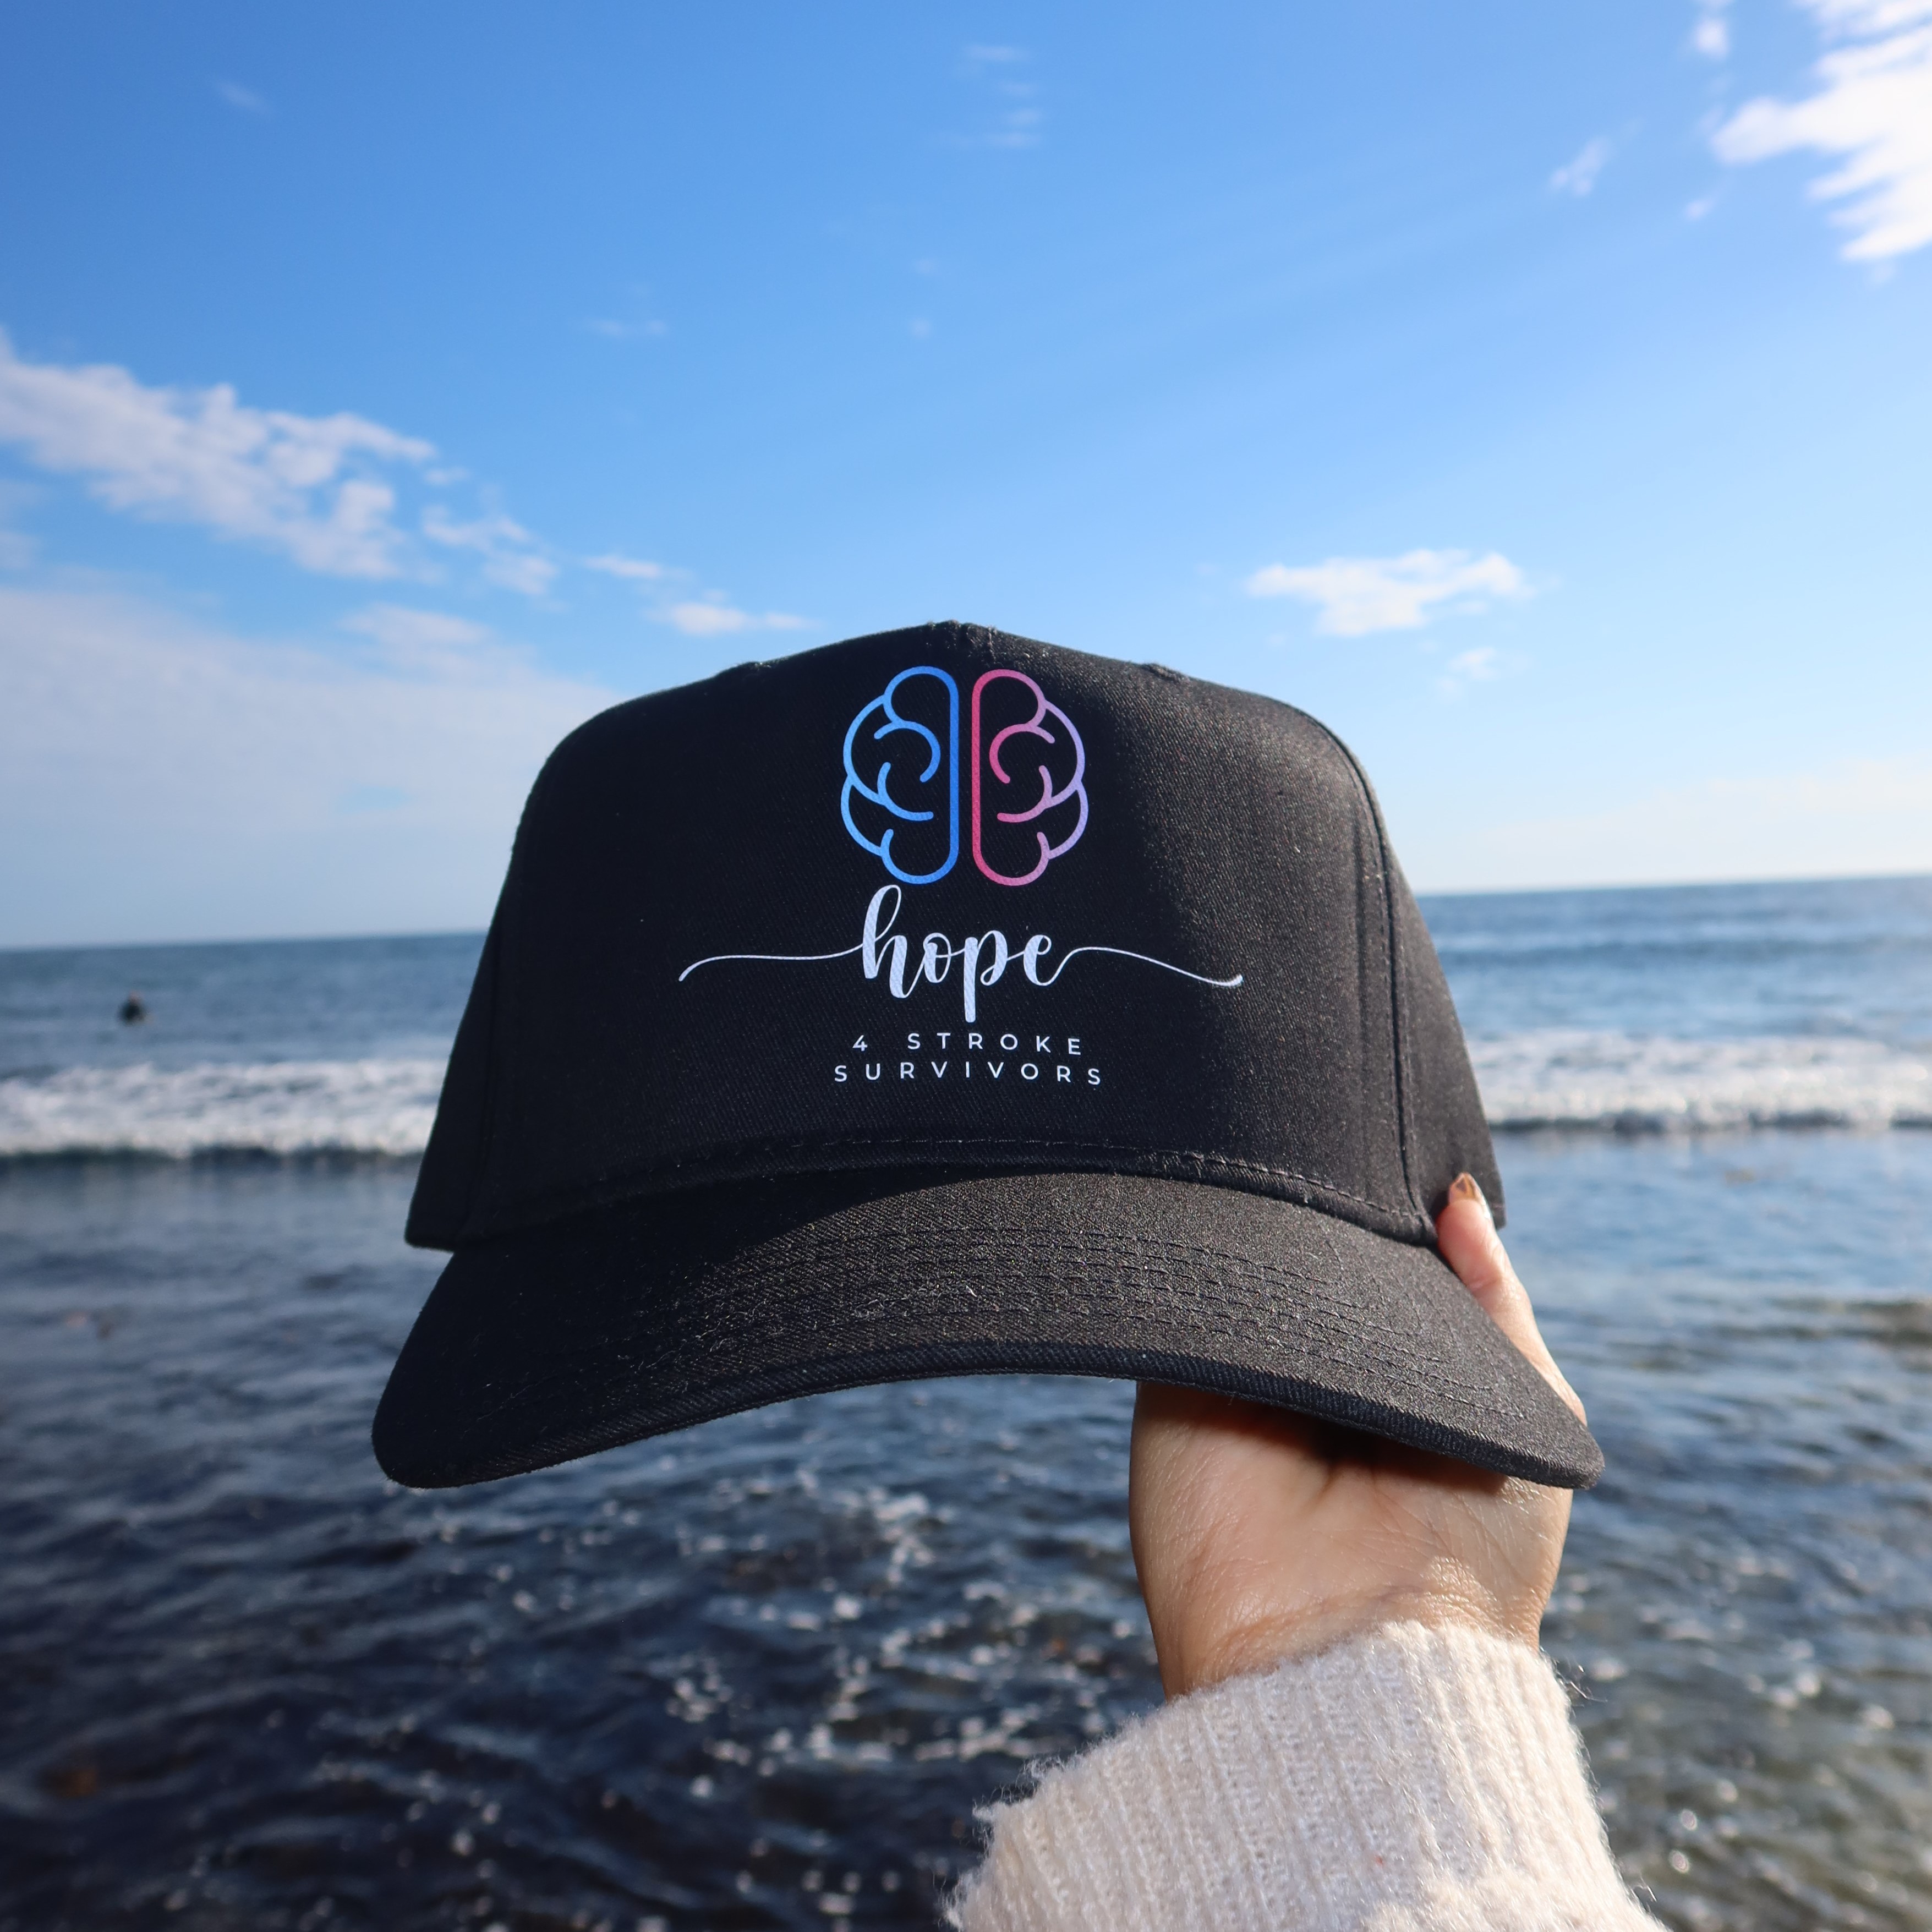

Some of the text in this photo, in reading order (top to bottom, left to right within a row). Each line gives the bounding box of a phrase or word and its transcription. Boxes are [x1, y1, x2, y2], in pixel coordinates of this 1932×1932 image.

[852, 1032, 1082, 1056] 4 STROKE
[834, 1060, 1101, 1086] SURVIVORS
